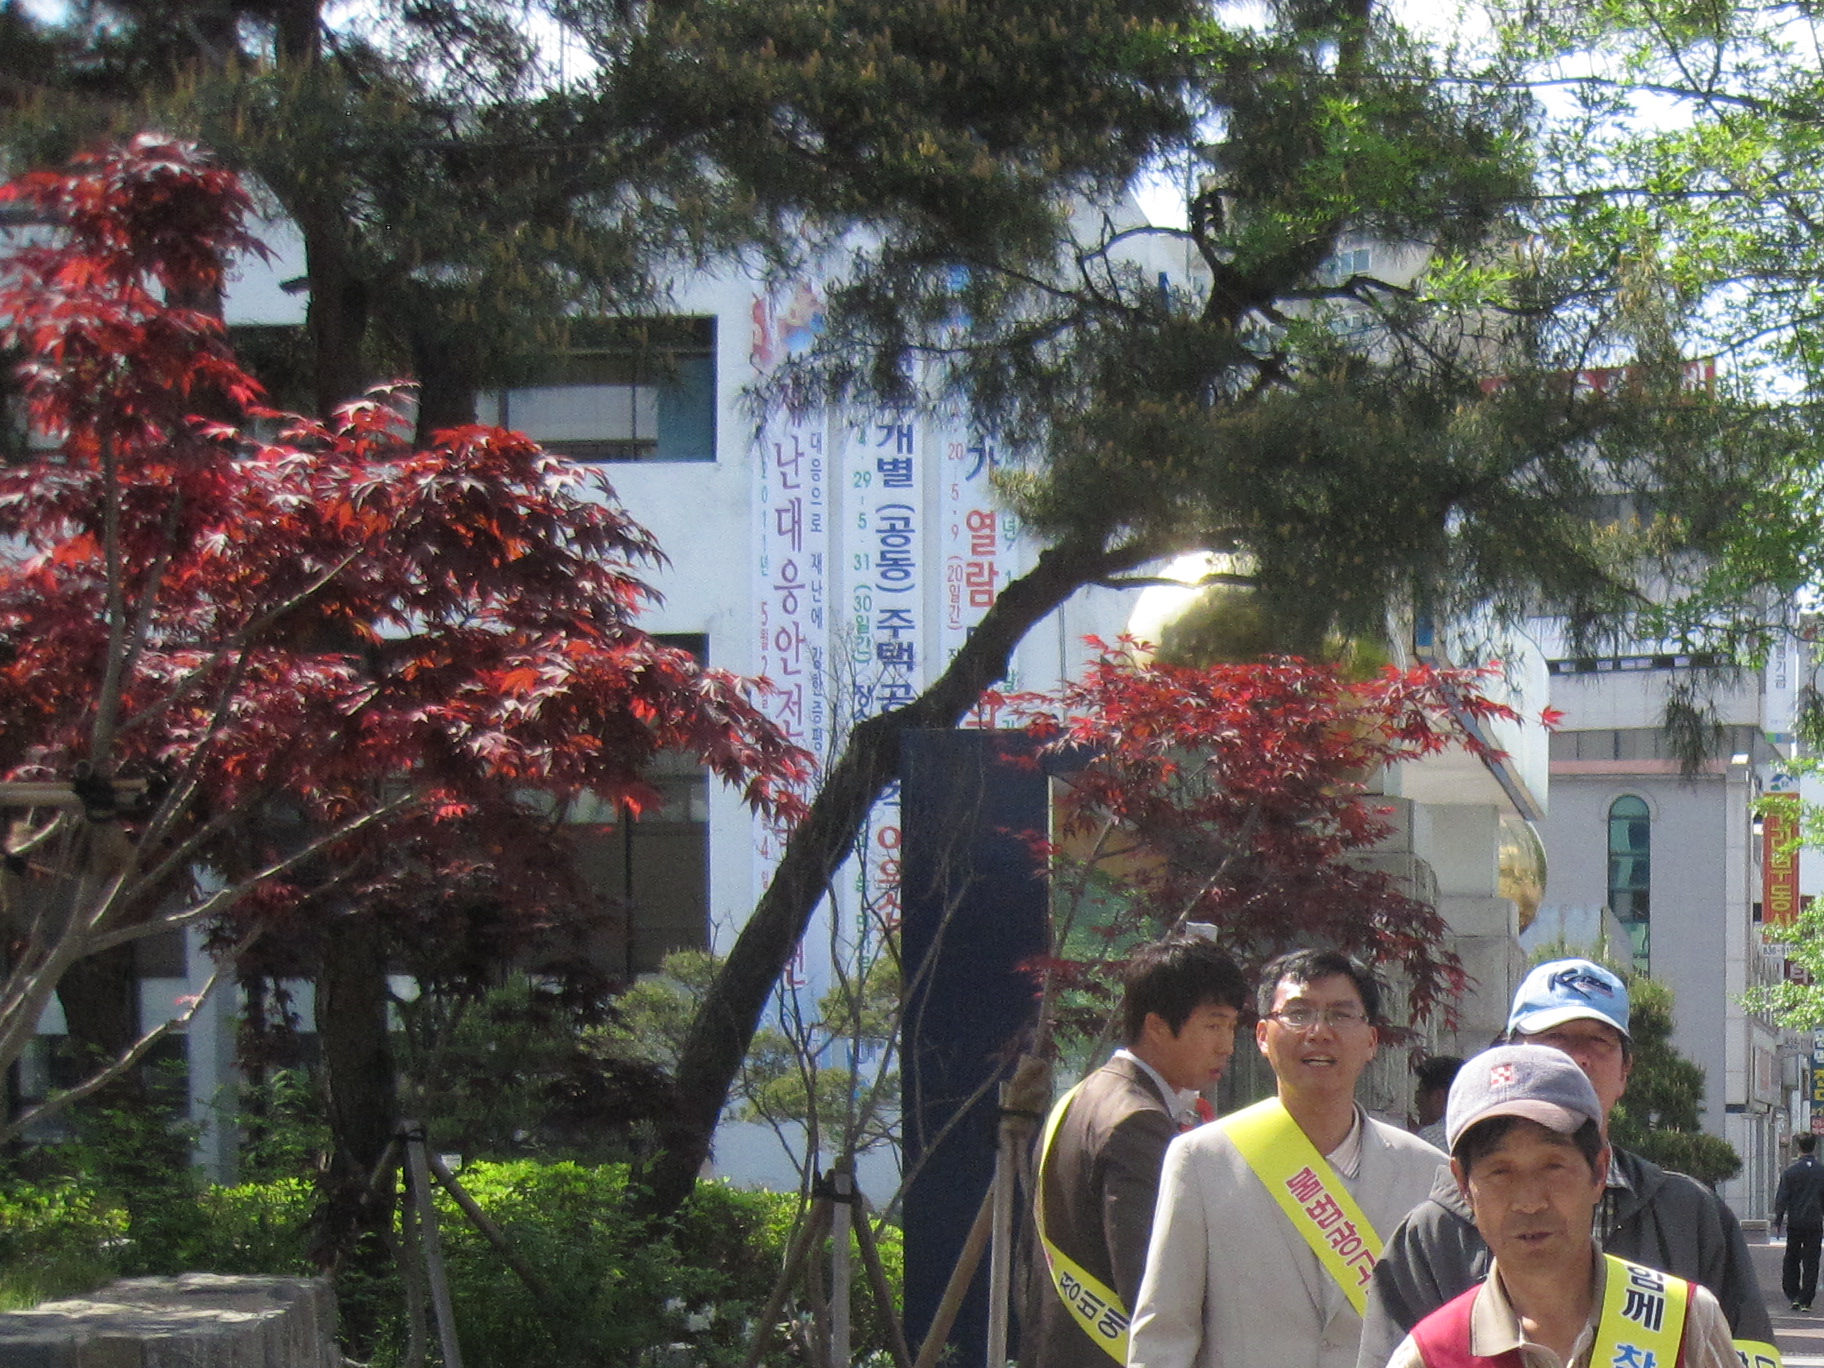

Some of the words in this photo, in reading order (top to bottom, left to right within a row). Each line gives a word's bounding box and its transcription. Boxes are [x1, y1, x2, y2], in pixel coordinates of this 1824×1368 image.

[965, 508, 999, 607] 열람
[1285, 1167, 1377, 1291] 불법광고
[1060, 1271, 1130, 1339] 정비에
